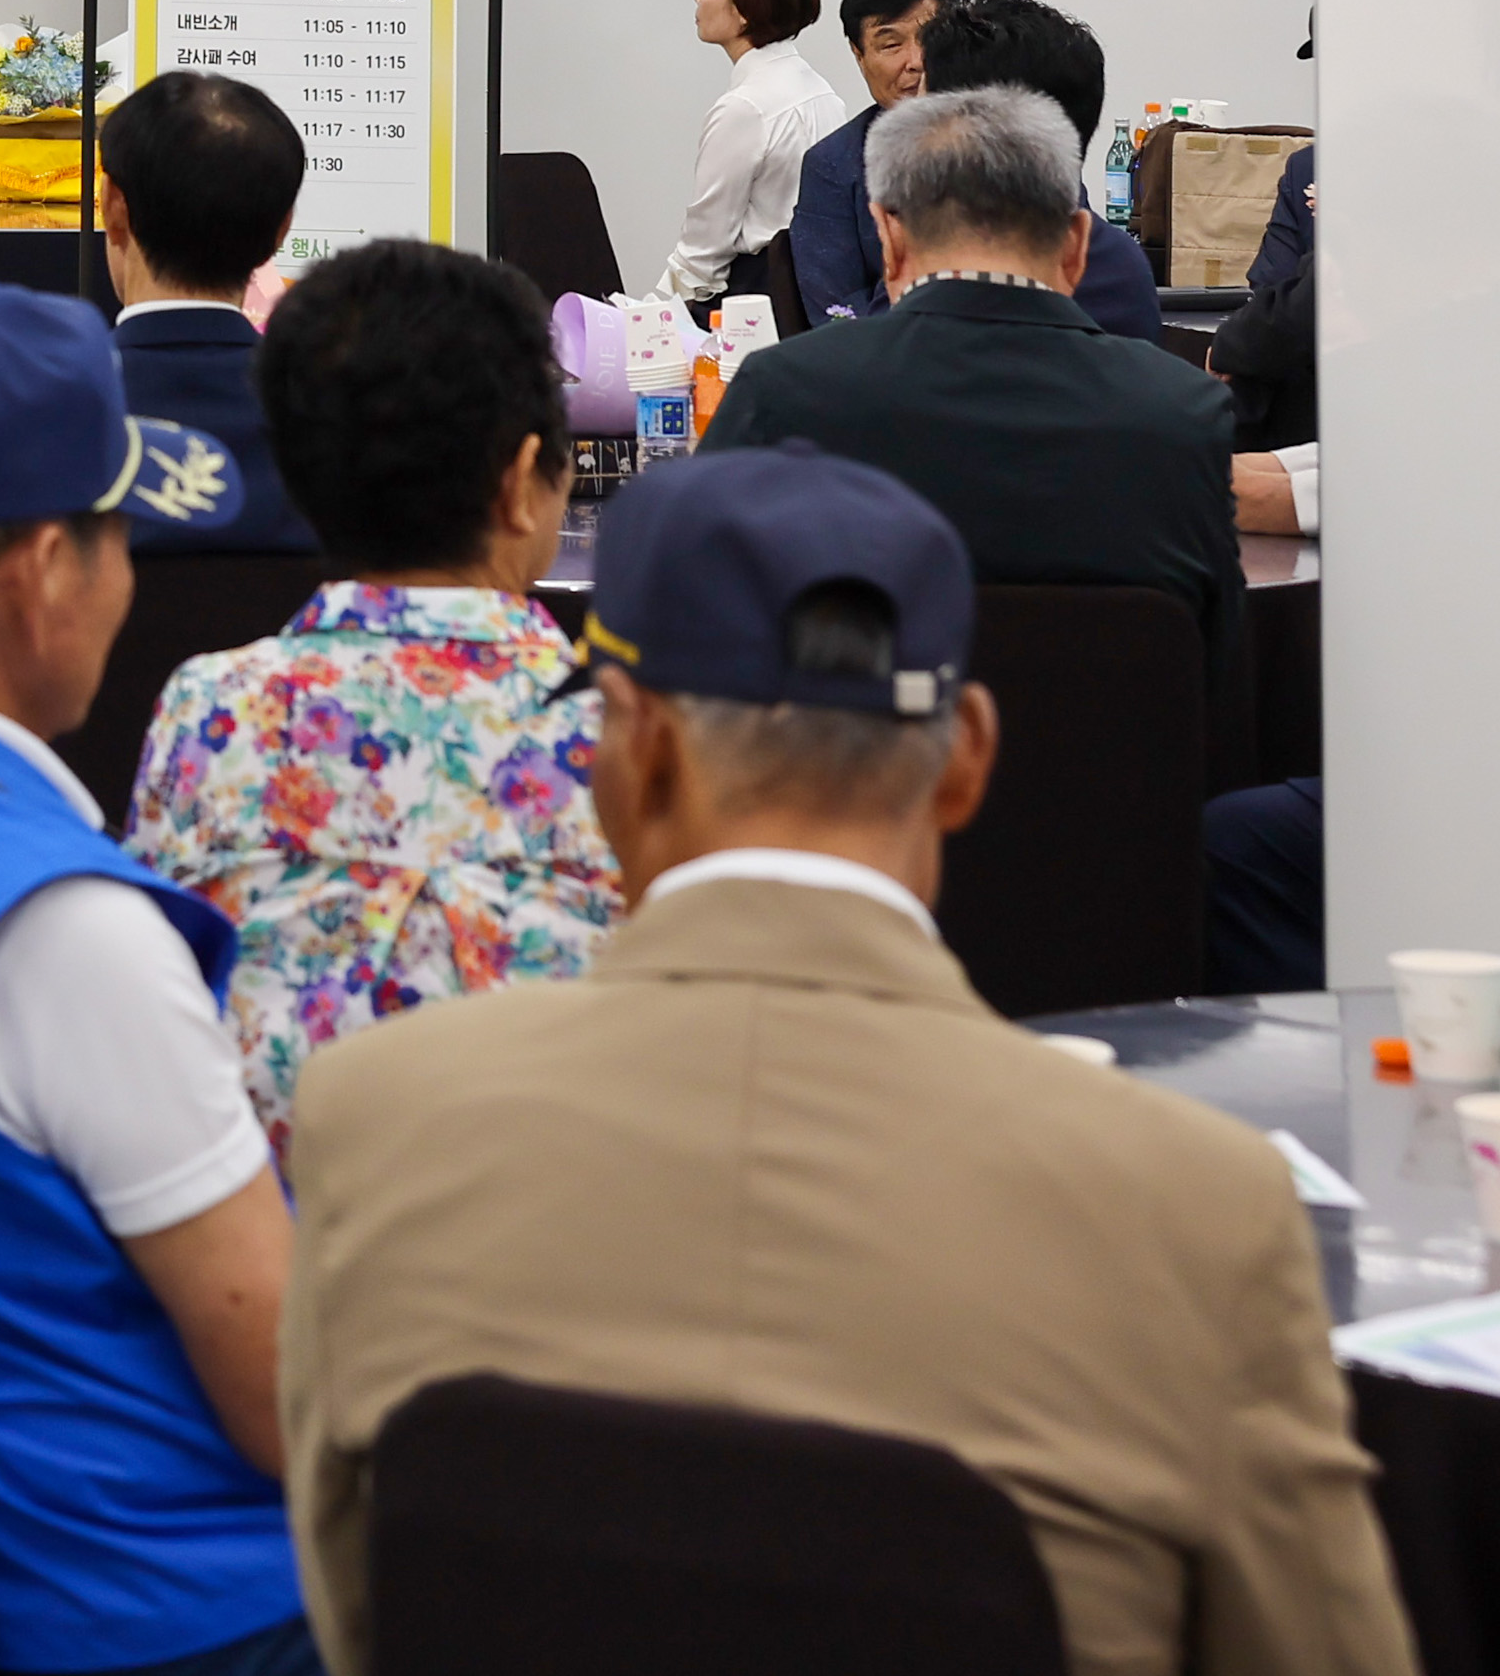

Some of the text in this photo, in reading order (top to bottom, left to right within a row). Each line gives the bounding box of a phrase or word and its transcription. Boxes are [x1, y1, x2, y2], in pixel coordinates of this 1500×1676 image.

[177, 14, 238, 31] 내빈소개
[304, 19, 344, 34] 11:05
[366, 21, 406, 35] 11:10
[177, 49, 222, 65] 감사패
[227, 50, 257, 66] 수여
[303, 54, 343, 68] 11:10
[366, 55, 406, 69] 11:15
[303, 88, 343, 102] 11:15
[366, 90, 405, 104] 11:17
[303, 123, 342, 137] 11:17
[365, 125, 405, 139] 11:30
[291, 238, 330, 259] 행사
